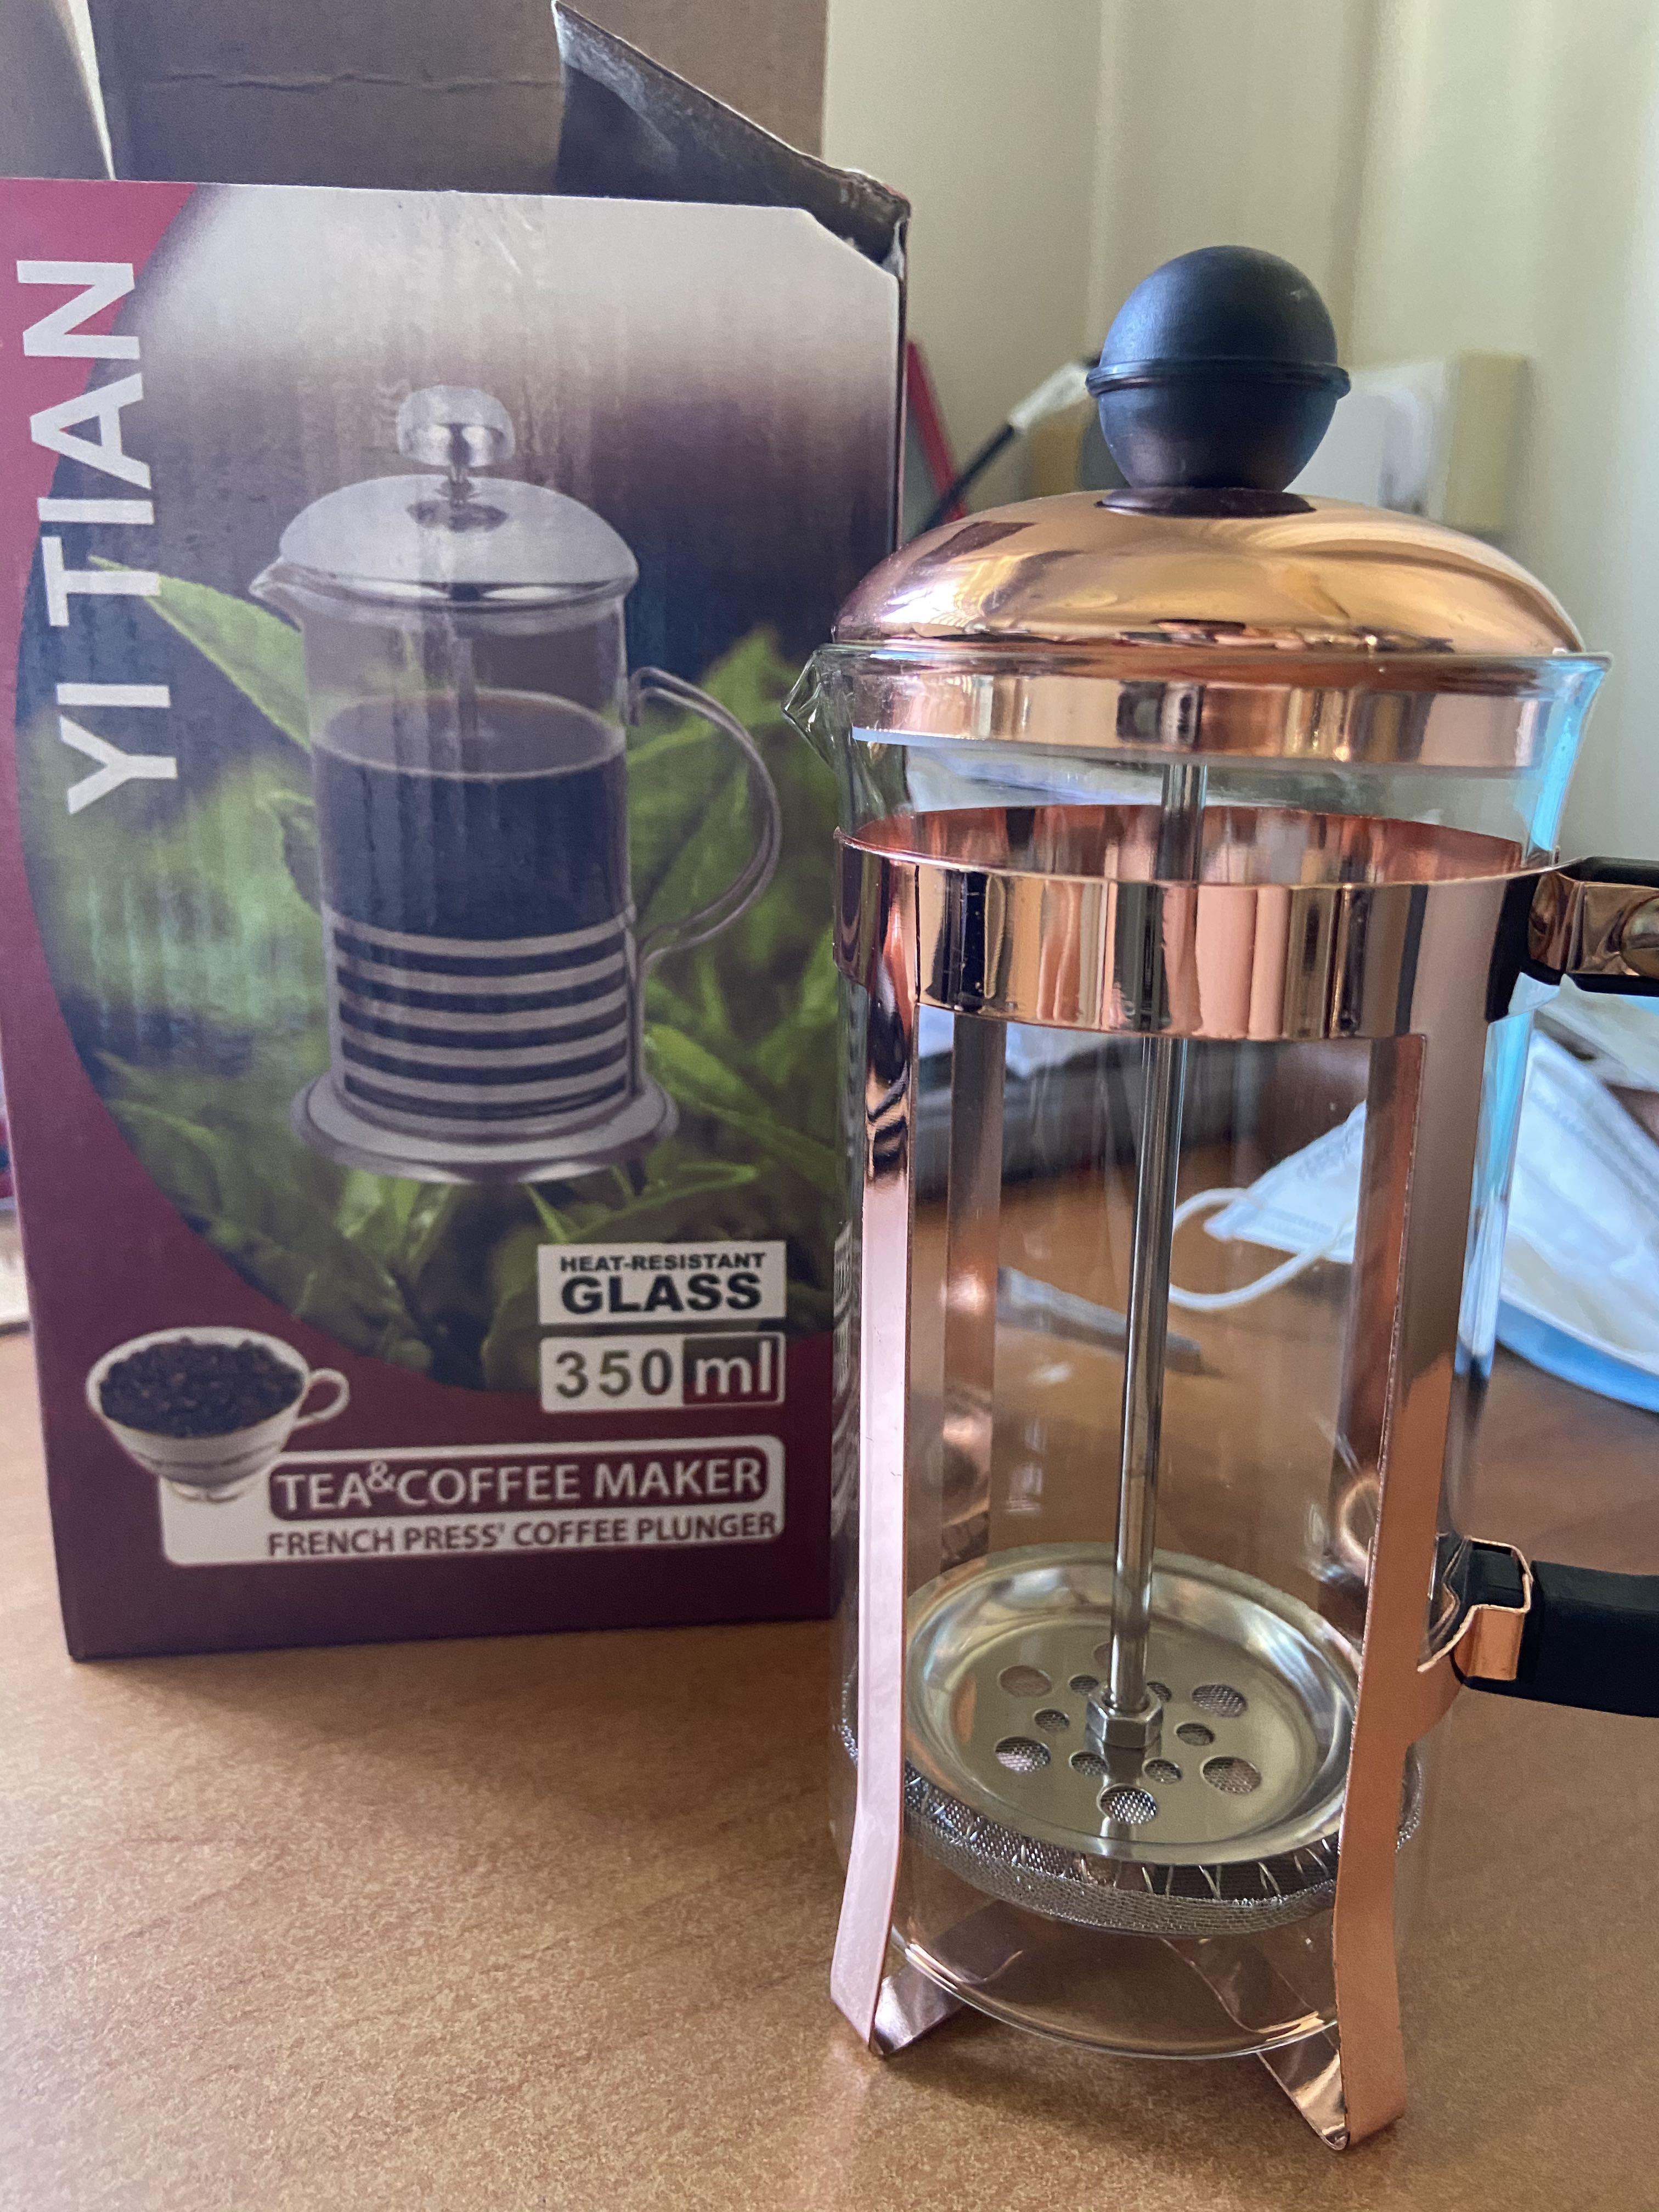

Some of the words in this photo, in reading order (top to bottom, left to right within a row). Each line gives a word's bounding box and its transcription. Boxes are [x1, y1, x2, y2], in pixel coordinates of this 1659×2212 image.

[16, 259, 161, 628] TIAN
[56, 682, 178, 814] YI
[560, 1252, 766, 1272] HEAT-RESISTANT
[561, 1272, 761, 1314] GLASS
[555, 1348, 673, 1398] 350
[694, 1339, 772, 1395] ml
[594, 1457, 762, 1498] MAKER
[268, 1527, 394, 1556] FRENCH
[514, 1518, 628, 1546] COFFEE
[635, 1511, 777, 1541] PLUNGER
